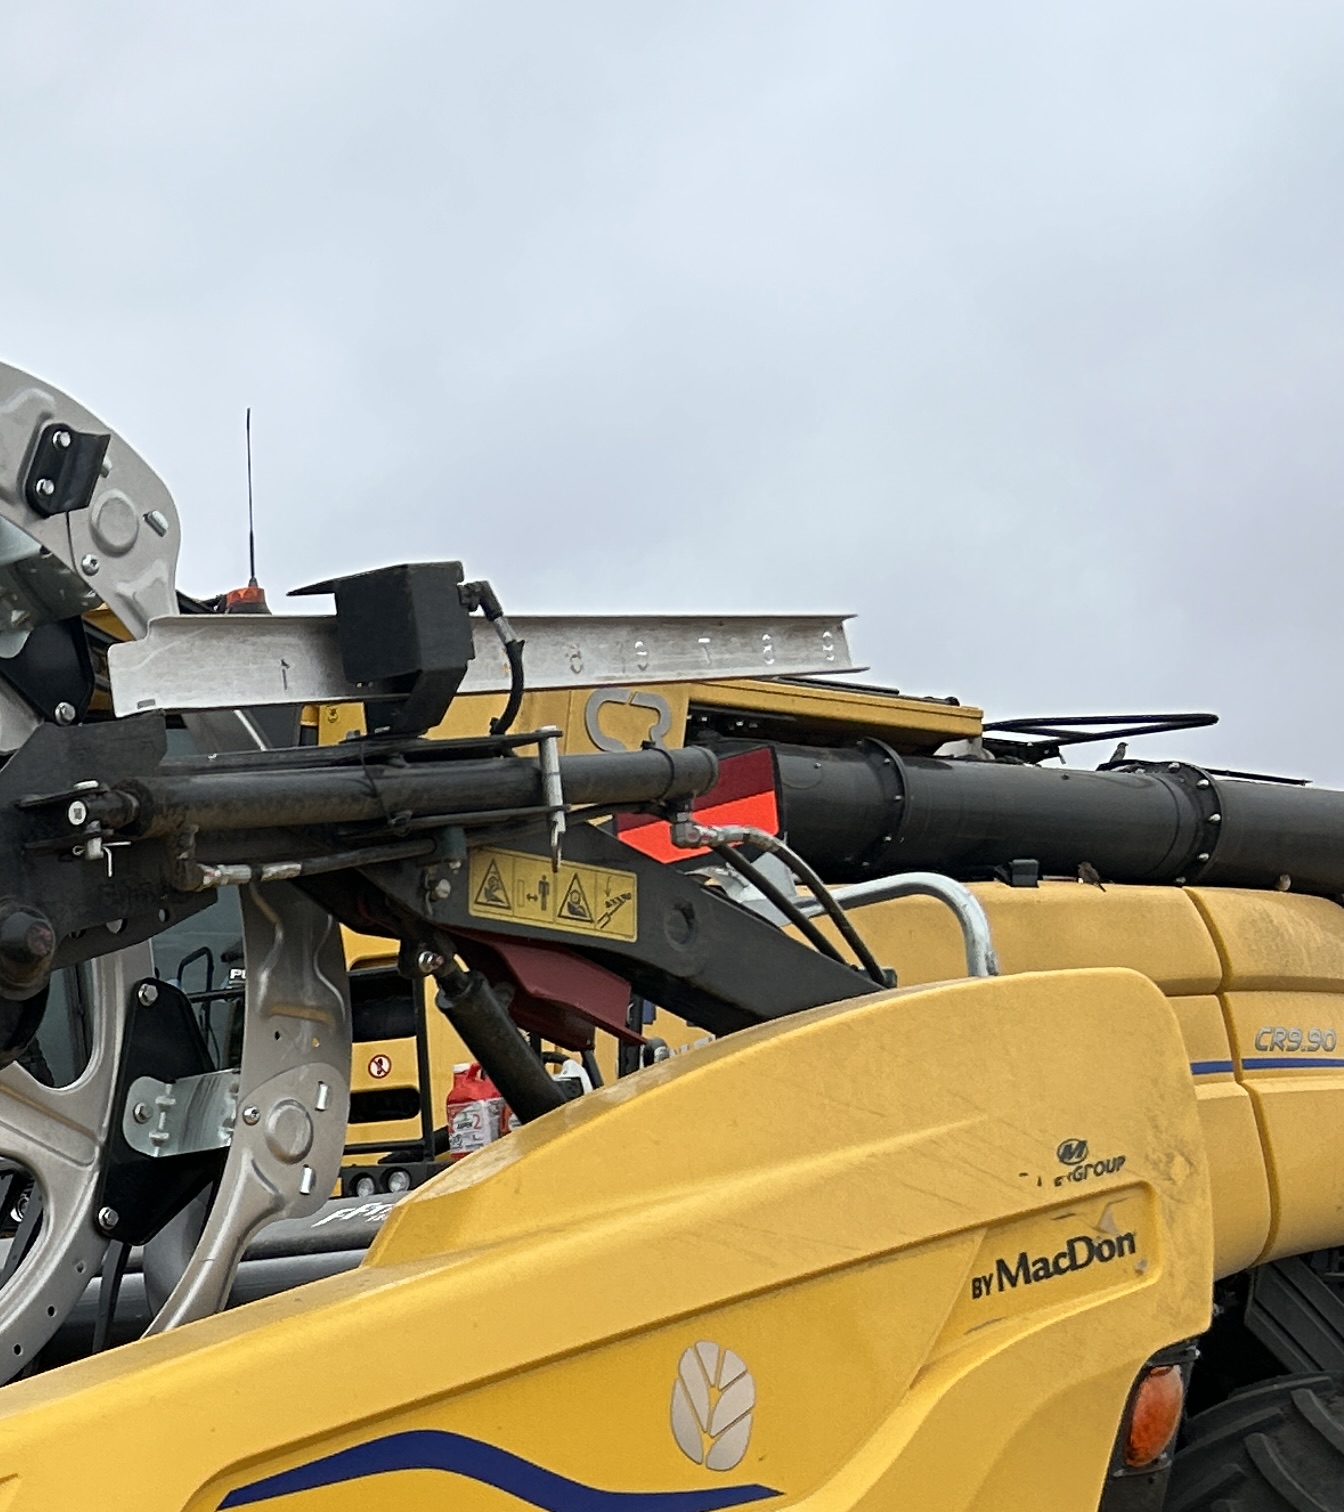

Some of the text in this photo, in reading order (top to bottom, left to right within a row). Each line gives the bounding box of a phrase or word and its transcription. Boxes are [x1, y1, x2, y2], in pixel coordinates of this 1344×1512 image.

[1254, 1026, 1337, 1053] CR9.90
[972, 1231, 1136, 1300] BY MacDon
